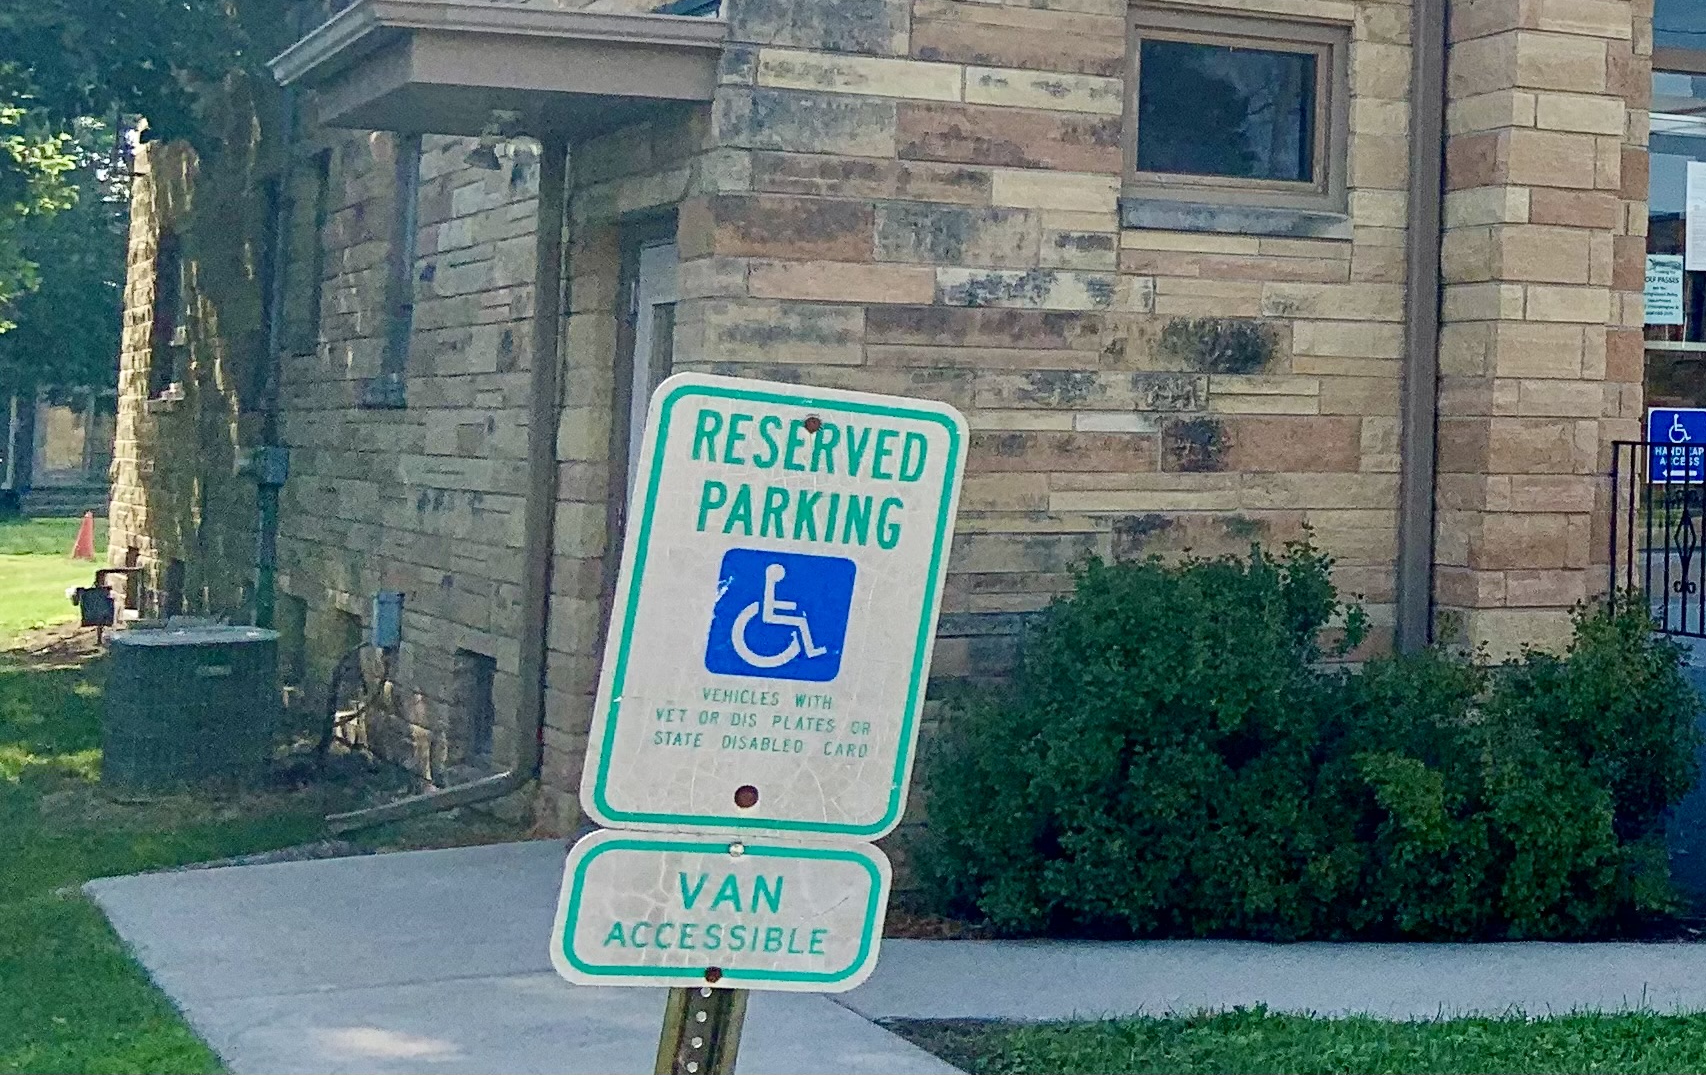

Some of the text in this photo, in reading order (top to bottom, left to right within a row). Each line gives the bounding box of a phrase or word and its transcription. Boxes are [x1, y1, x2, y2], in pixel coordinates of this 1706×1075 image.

[691, 408, 929, 483] RESERVED
[696, 479, 905, 551] PARKING
[702, 687, 833, 710] VEHICLES WITH
[655, 707, 872, 736] VET OR DIS PLATES OR
[653, 730, 869, 759] STATE DISABLED CARD
[678, 871, 784, 915] VAN
[602, 920, 828, 956] ACCESSIBLE
